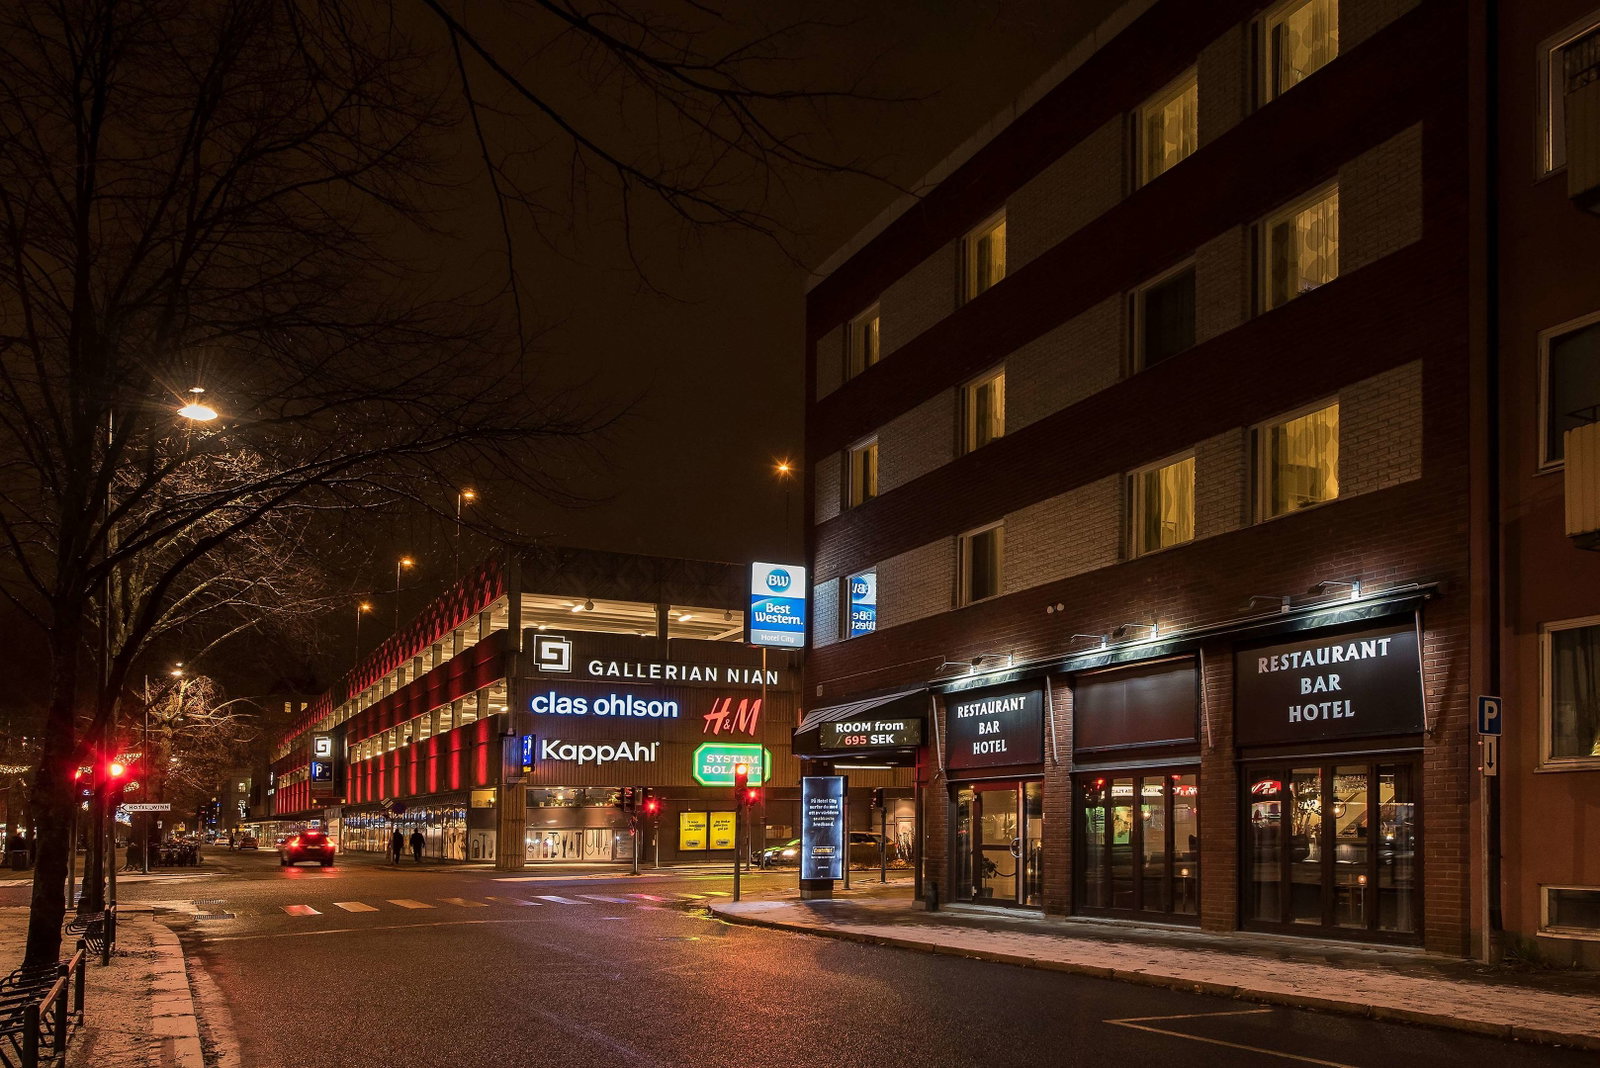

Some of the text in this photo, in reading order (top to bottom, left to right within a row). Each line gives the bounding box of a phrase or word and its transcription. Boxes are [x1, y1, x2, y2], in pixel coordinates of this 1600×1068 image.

[769, 574, 789, 587] BW
[766, 602, 791, 614] Best
[761, 634, 794, 644] Hotel City
[1258, 637, 1391, 674] RESTAURANT
[588, 660, 778, 685] GALLERIAN NIAN
[1300, 673, 1342, 695] BAR
[531, 691, 679, 718] clas ohlson
[957, 696, 1026, 719] RESTAURANT
[1289, 700, 1355, 722] HOTEL
[703, 697, 762, 736] H&M
[1484, 700, 1498, 731] P
[835, 721, 904, 733] ROOM from
[978, 720, 1000, 735] BAR
[844, 734, 895, 746] 695 SEK
[973, 739, 1008, 755] HOTEL
[541, 739, 657, 765] KappAhl
[706, 754, 759, 764] SYSTEM
[702, 765, 762, 775] BOLAET
